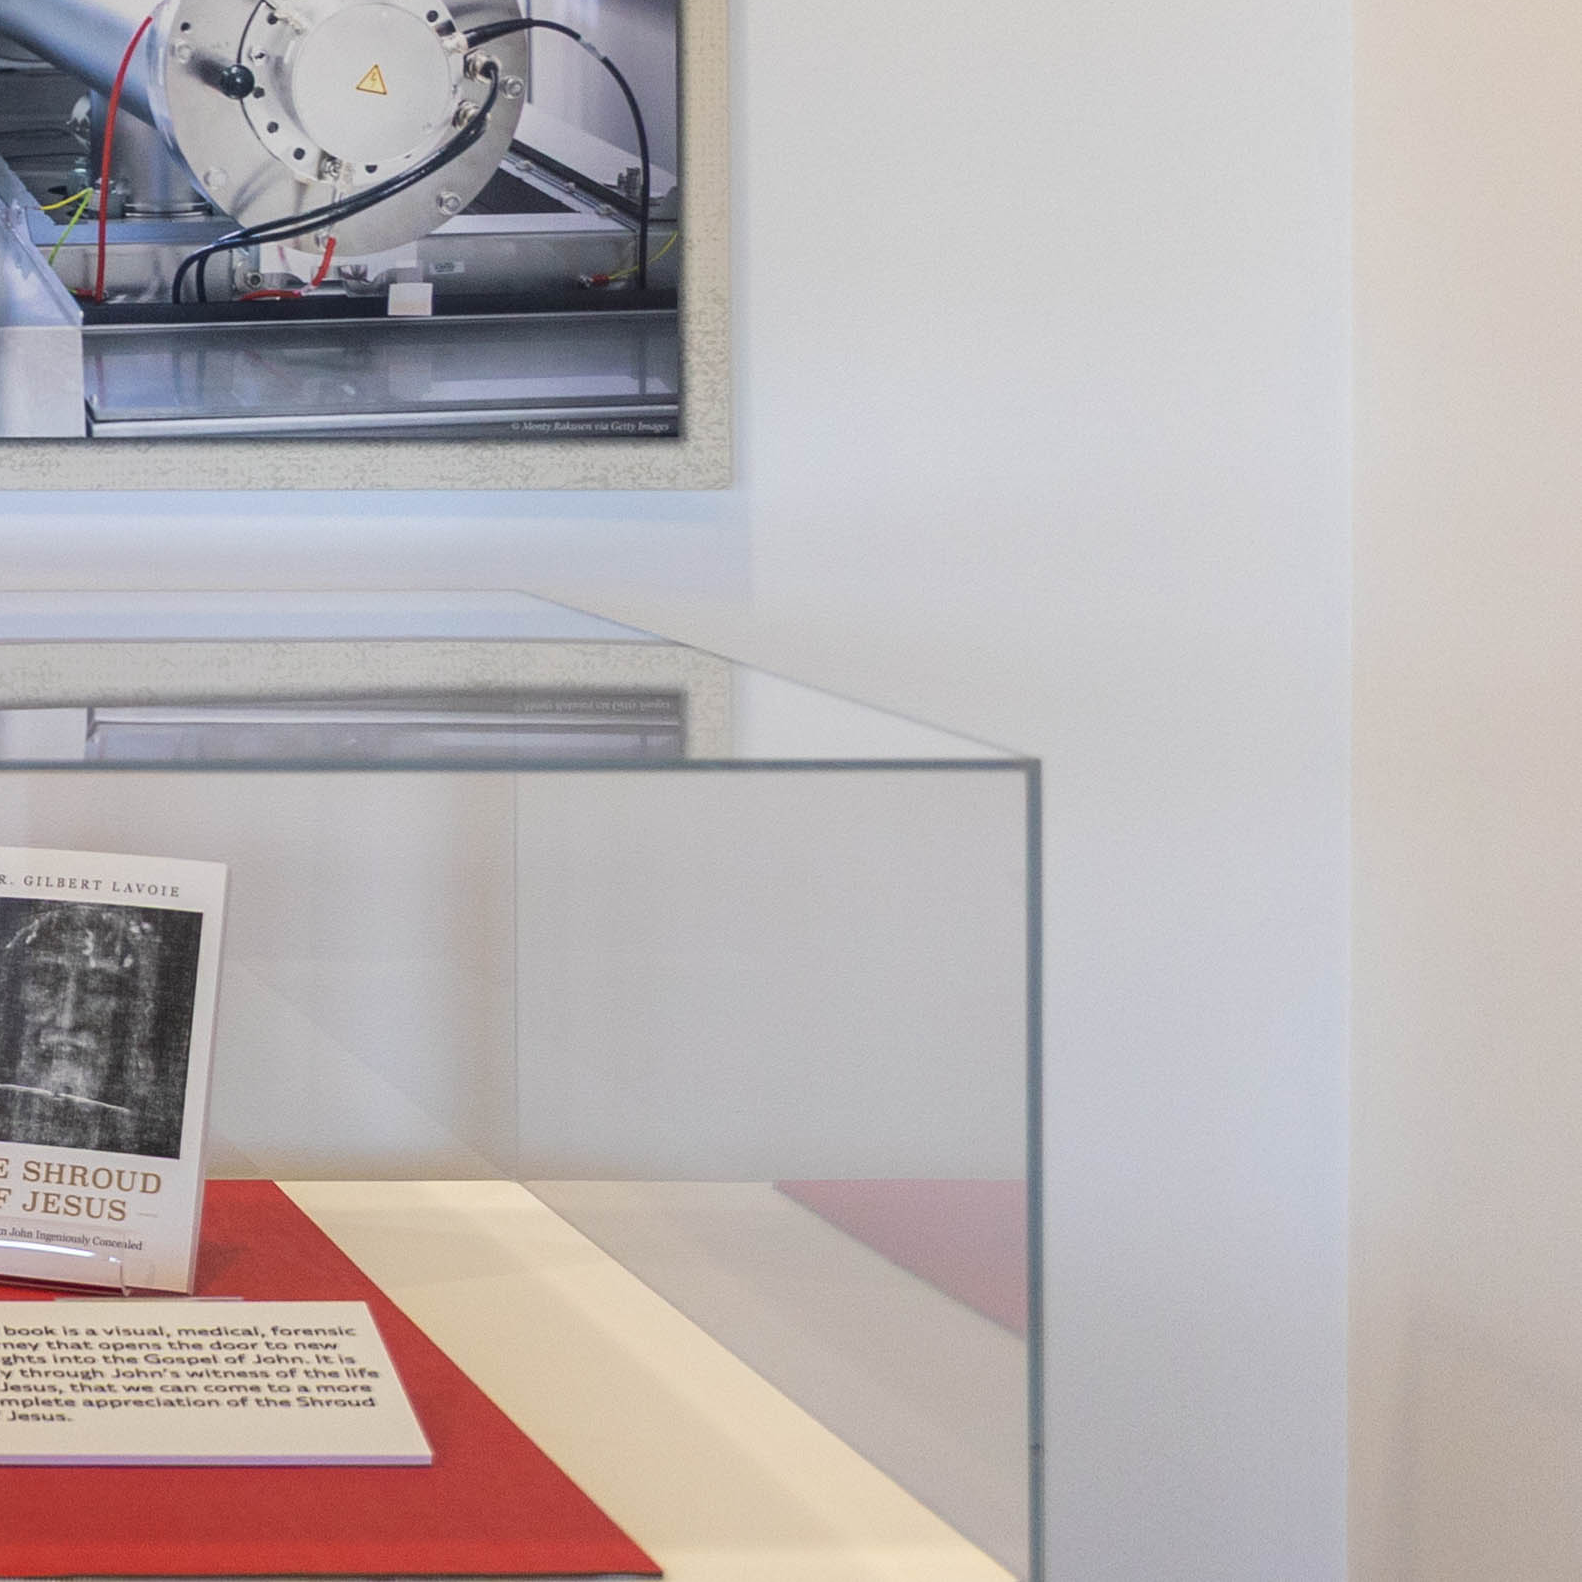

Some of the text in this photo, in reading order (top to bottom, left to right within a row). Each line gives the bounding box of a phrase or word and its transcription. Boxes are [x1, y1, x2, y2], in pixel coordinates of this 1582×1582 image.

[611, 421, 636, 432] Getty
[638, 421, 669, 433] Images
[23, 875, 103, 891] GILBERT
[112, 881, 181, 898] LAVOIE
[22, 1160, 162, 1194] SHROUD
[21, 1191, 127, 1222] JESUS
[9, 1227, 33, 1239] John
[36, 1229, 90, 1245] Ingeniously
[92, 1235, 143, 1251] Concealed
[4, 1326, 55, 1336] book
[63, 1326, 79, 1336] is
[103, 1326, 170, 1338] visual,
[177, 1326, 265, 1338] medical,
[271, 1326, 355, 1336] forensic
